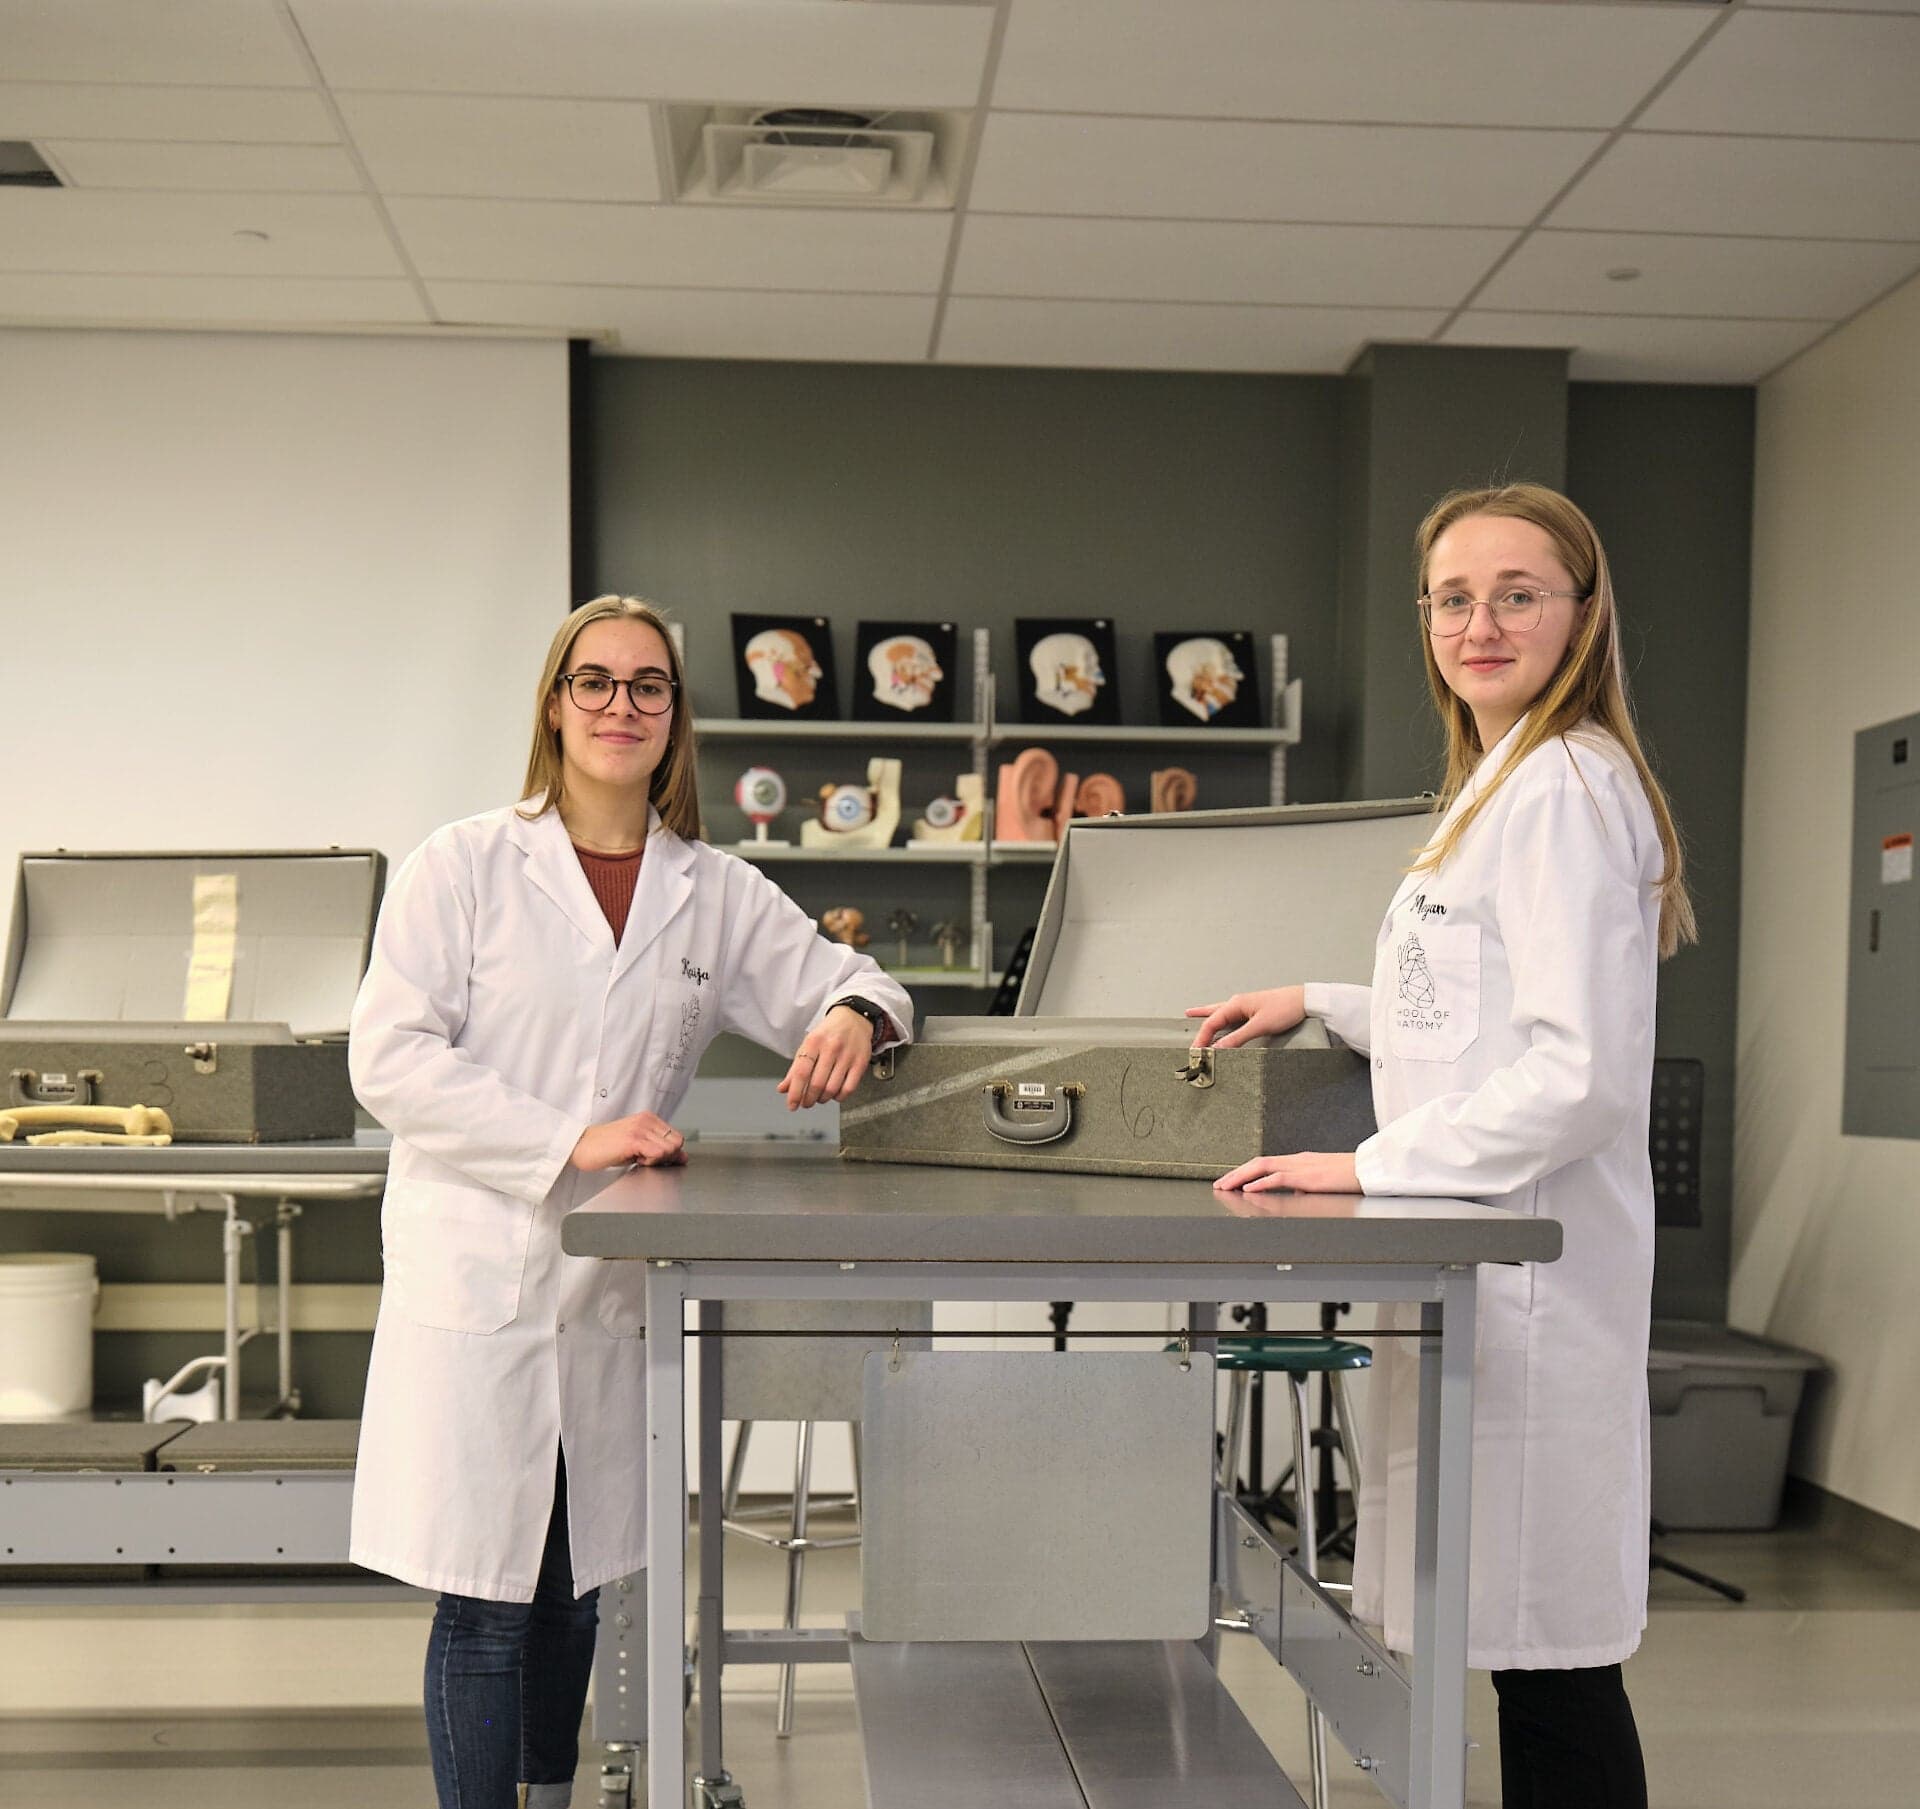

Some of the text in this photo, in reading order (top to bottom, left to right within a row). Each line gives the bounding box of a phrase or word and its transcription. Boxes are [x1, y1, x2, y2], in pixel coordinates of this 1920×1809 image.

[1410, 894, 1447, 921] Megan
[681, 957, 710, 986] Kaija
[1433, 1010, 1451, 1019] OF
[1121, 1064, 1155, 1138] 6
